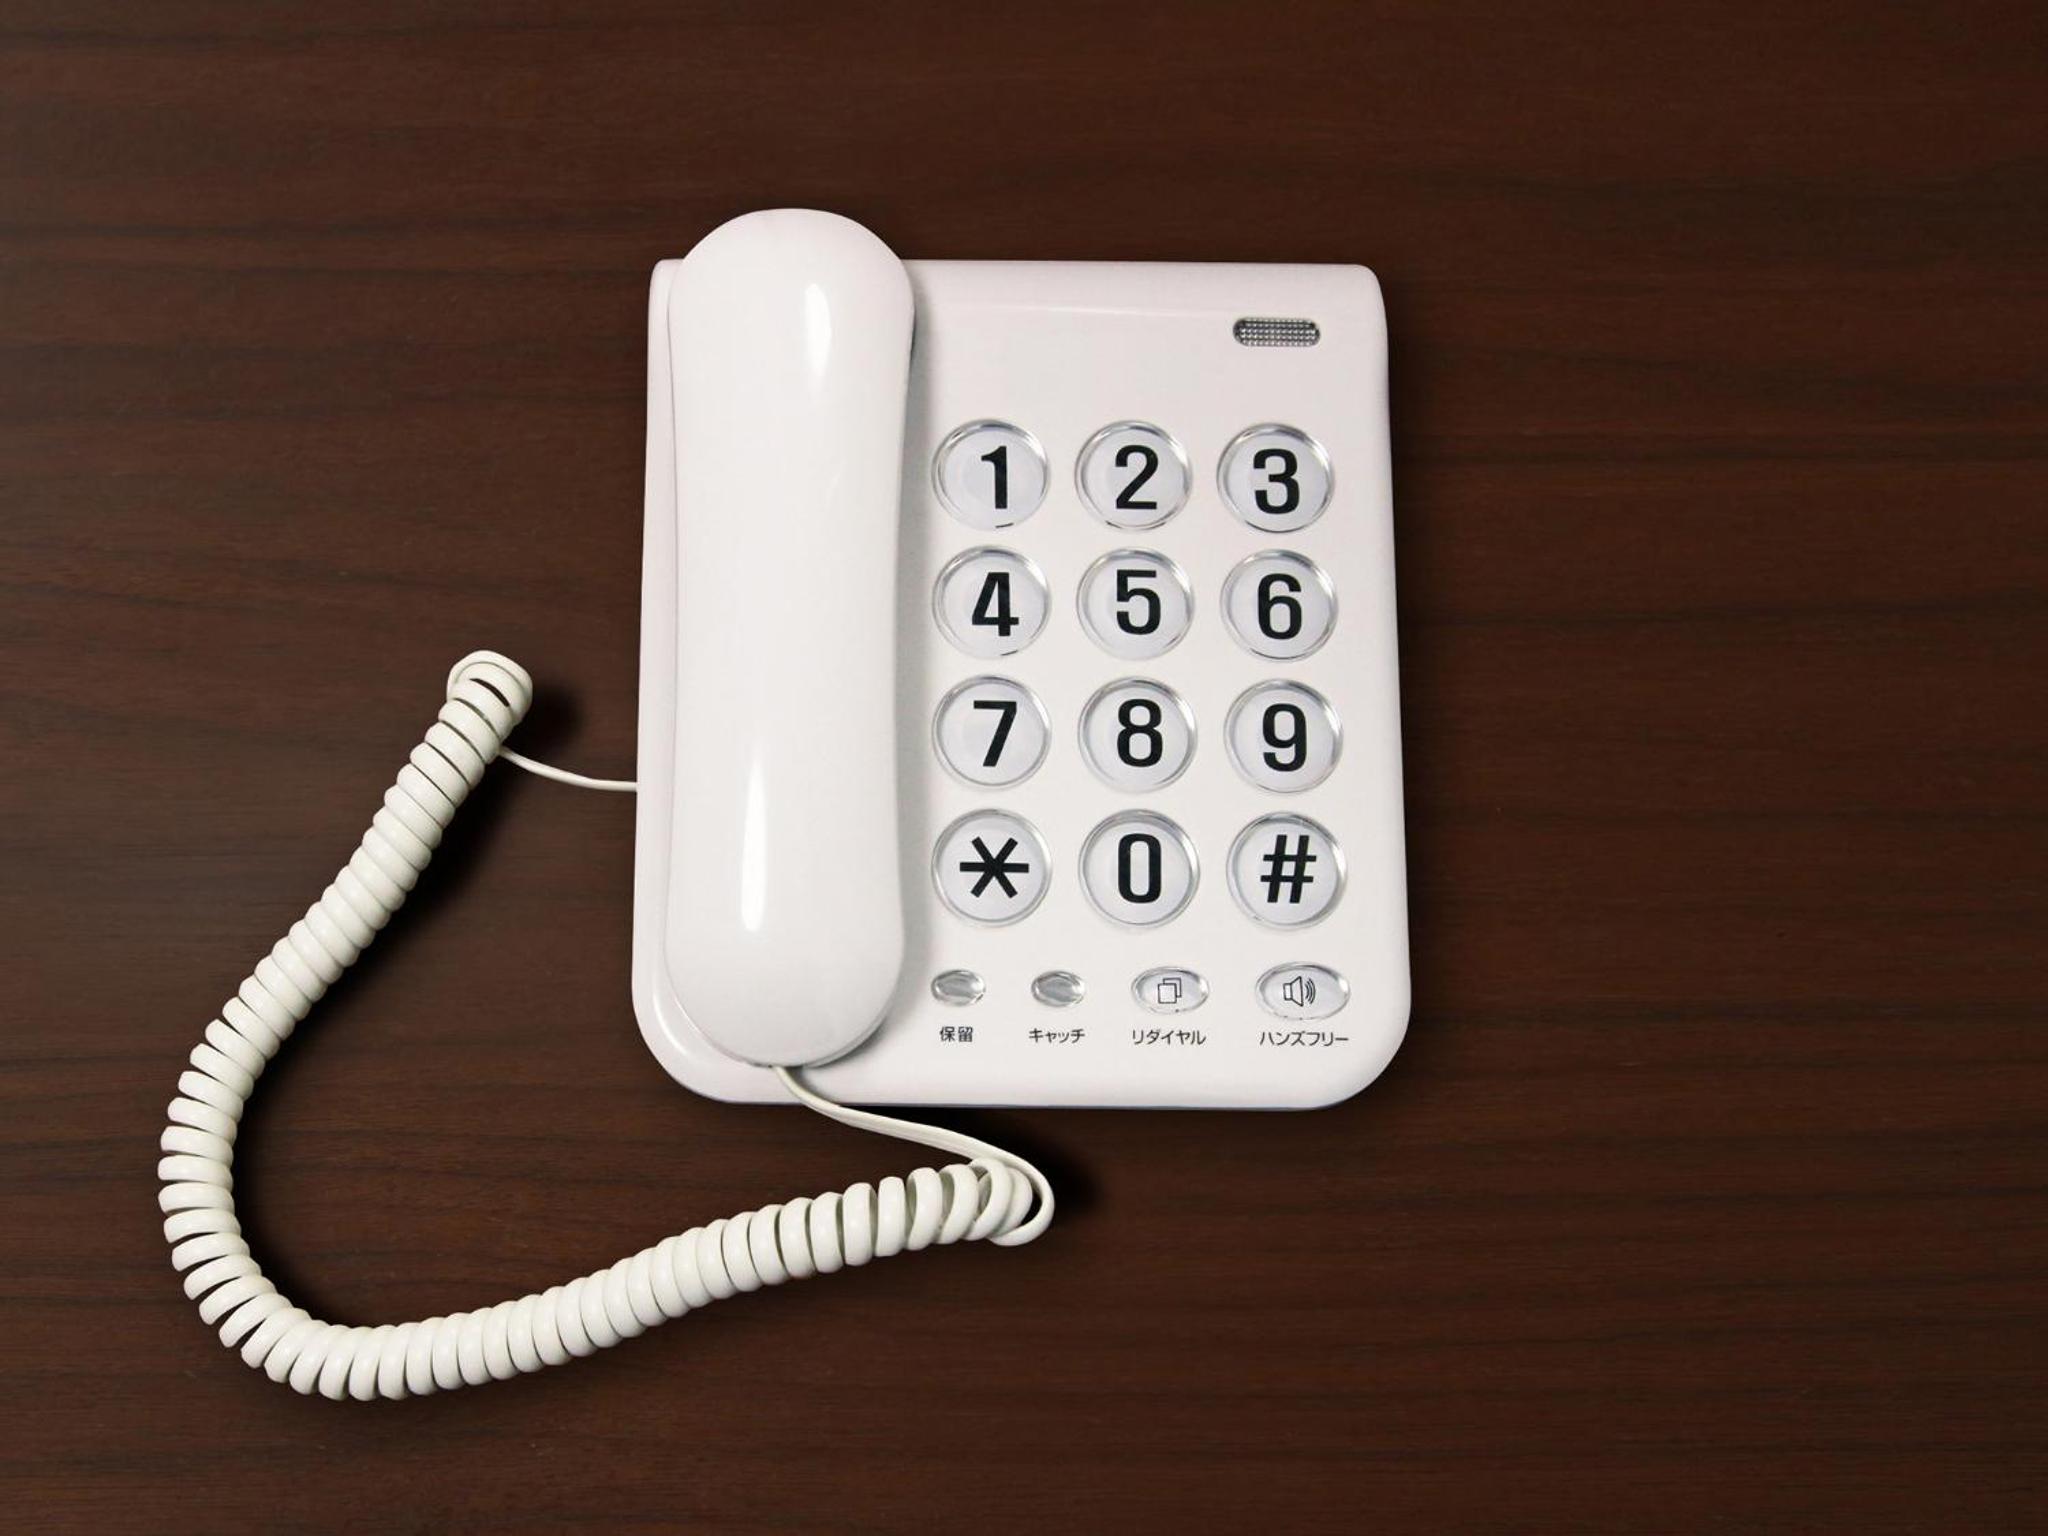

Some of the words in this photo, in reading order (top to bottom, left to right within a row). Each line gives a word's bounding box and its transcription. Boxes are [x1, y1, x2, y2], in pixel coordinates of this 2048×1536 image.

[981, 445, 1008, 510] 1
[1115, 444, 1159, 510] 2
[1253, 449, 1301, 515] 3
[971, 571, 1020, 637] 4
[1116, 569, 1161, 636] 5
[1257, 573, 1303, 640] 6
[973, 700, 1017, 767] 7
[1116, 698, 1163, 768] 8
[1262, 703, 1307, 772] 9
[1117, 833, 1162, 904] 0
[1260, 834, 1318, 904] #
[939, 1025, 974, 1043] 保留
[1028, 1027, 1086, 1044] キャッチ
[1132, 1029, 1207, 1046] リダイヤル
[1259, 1030, 1349, 1047] ハンズフリー
